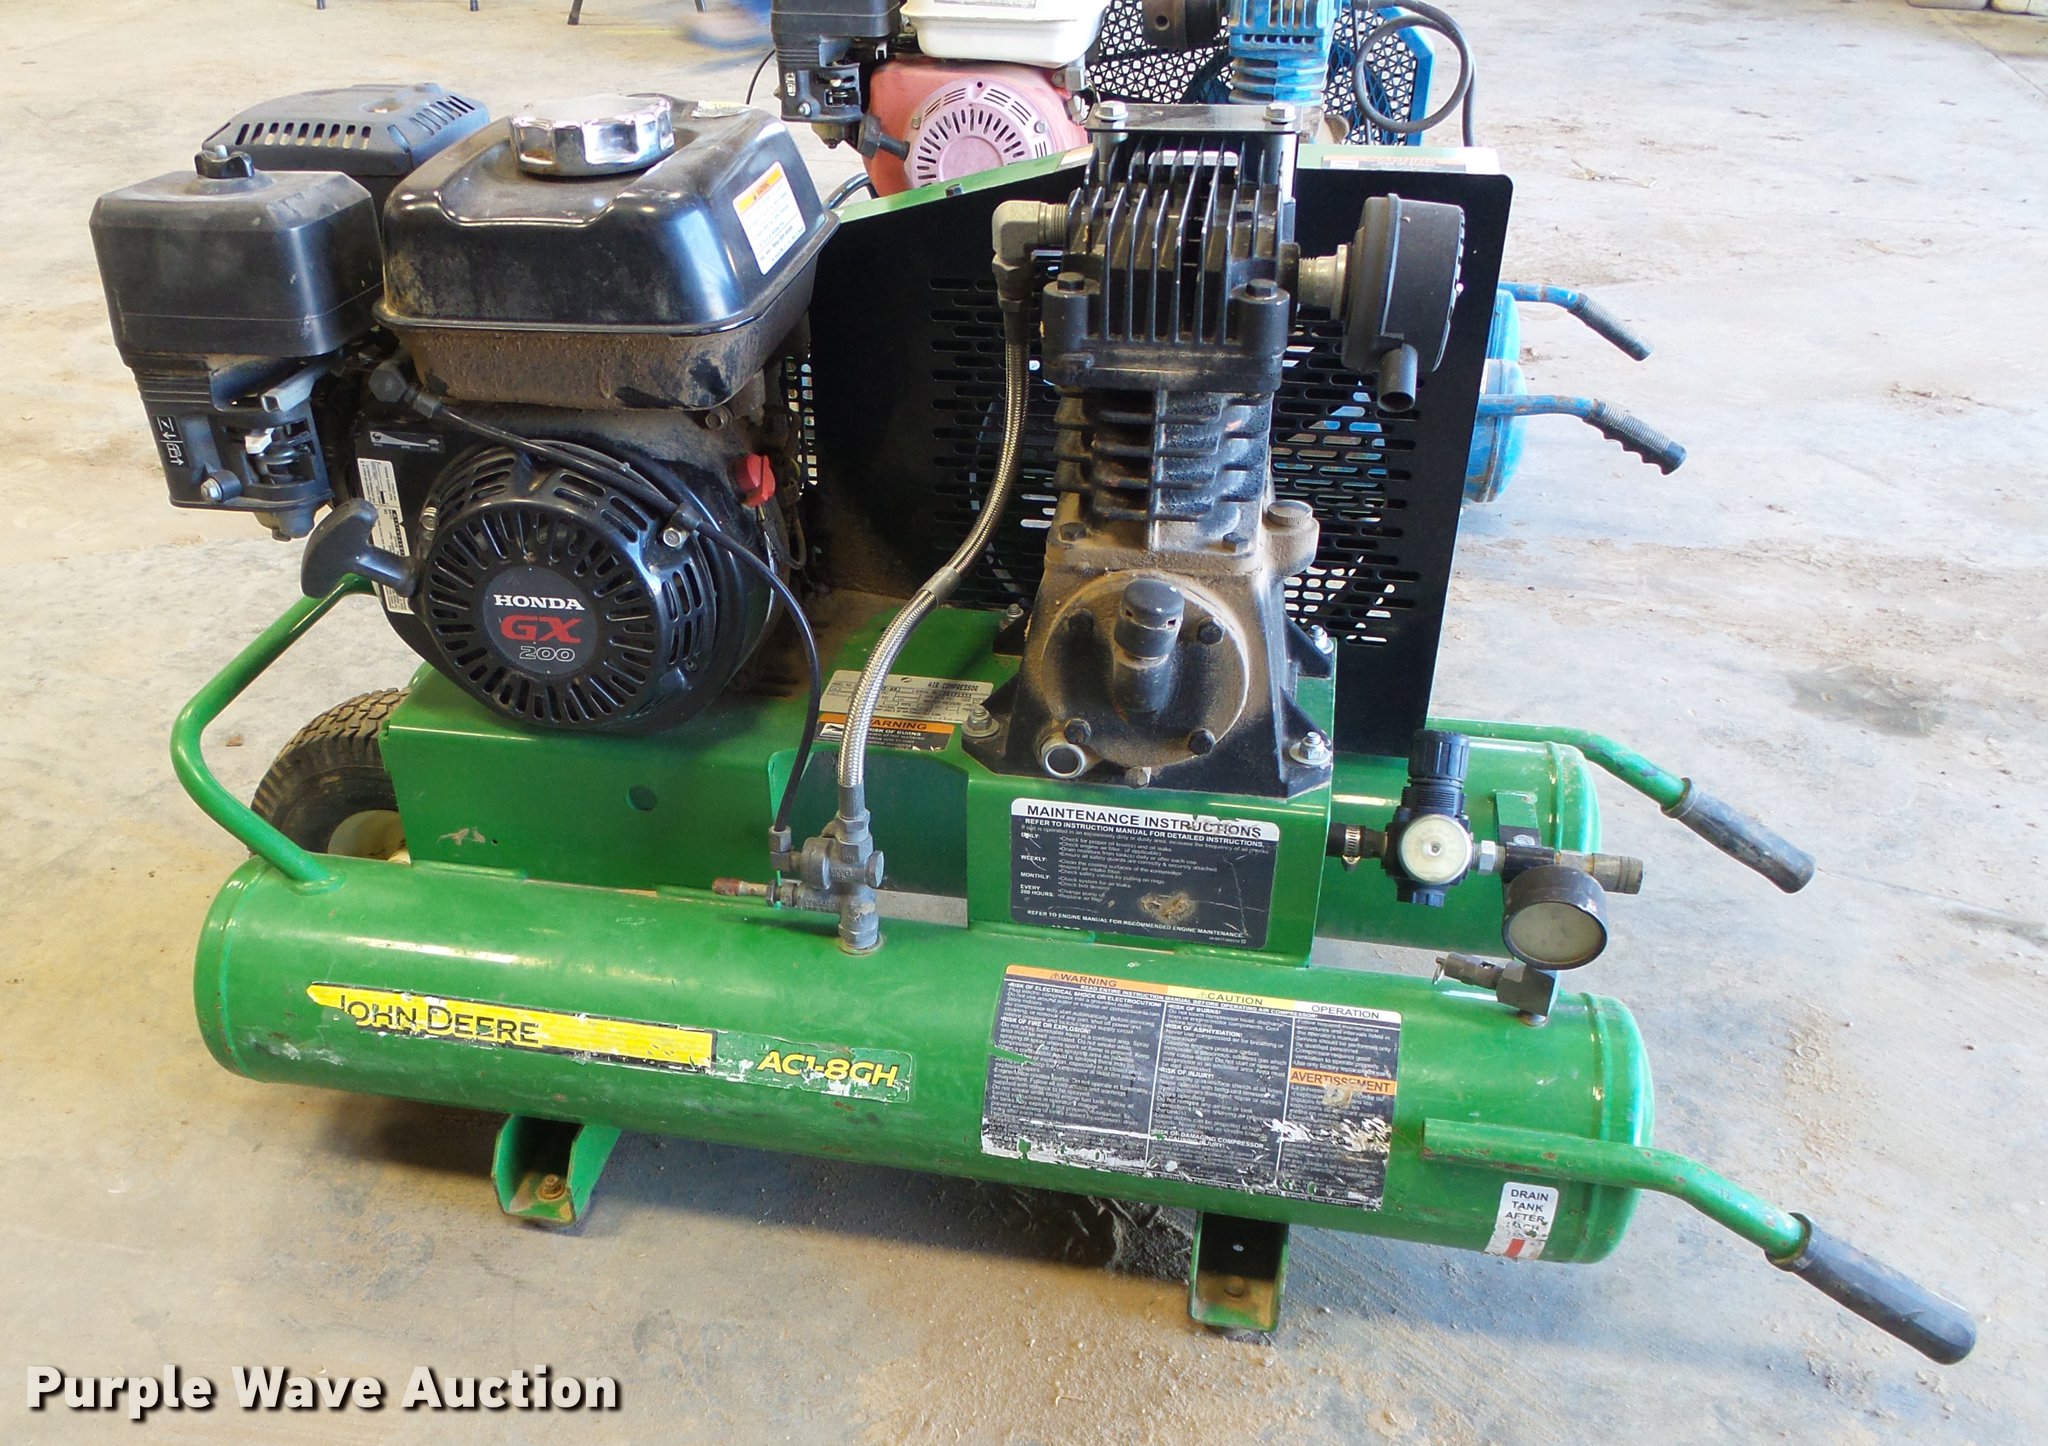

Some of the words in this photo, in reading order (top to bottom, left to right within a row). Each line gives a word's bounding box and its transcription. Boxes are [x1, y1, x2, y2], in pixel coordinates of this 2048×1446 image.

[493, 594, 585, 610] HONDA
[500, 614, 584, 644] GX
[519, 646, 575, 662] 200
[942, 682, 978, 691] COMPRESSOR
[870, 720, 927, 730] ARNING
[1027, 805, 1139, 825] MAINTENANCE
[1144, 816, 1260, 837] INSTRUCTIONS
[1025, 818, 1049, 826] REFER
[1063, 821, 1113, 832] INSTRUCTION
[1115, 826, 1147, 835] MANUAL
[1150, 830, 1164, 838] FOR
[1167, 832, 1203, 841] DETAILED
[1206, 835, 1264, 847] INSTRUCTIONS.
[1027, 909, 1047, 917] REFER
[1058, 912, 1080, 920] ENGINE
[1082, 915, 1107, 923] MANUAL
[1123, 919, 1171, 929] RECOMMENDED
[1172, 925, 1195, 933] ENGINE
[1060, 973, 1117, 987] WARNING
[1035, 986, 1072, 995] ELECTRICAL
[1207, 990, 1263, 1005] CAUTION
[1122, 990, 1163, 1000] INSTRUCTION
[1220, 1003, 1256, 1011] OPERATING
[1311, 1004, 1378, 1019] OPERATION
[340, 995, 416, 1027] JOHN
[428, 1005, 539, 1044] DEERE
[1187, 1070, 1213, 1078] INJURY!
[1217, 1137, 1263, 1148] COMPRESSOR
[1510, 1188, 1548, 1201] DRAIN
[1512, 1200, 1543, 1212] TANK
[1504, 1210, 1545, 1222] AFTER
